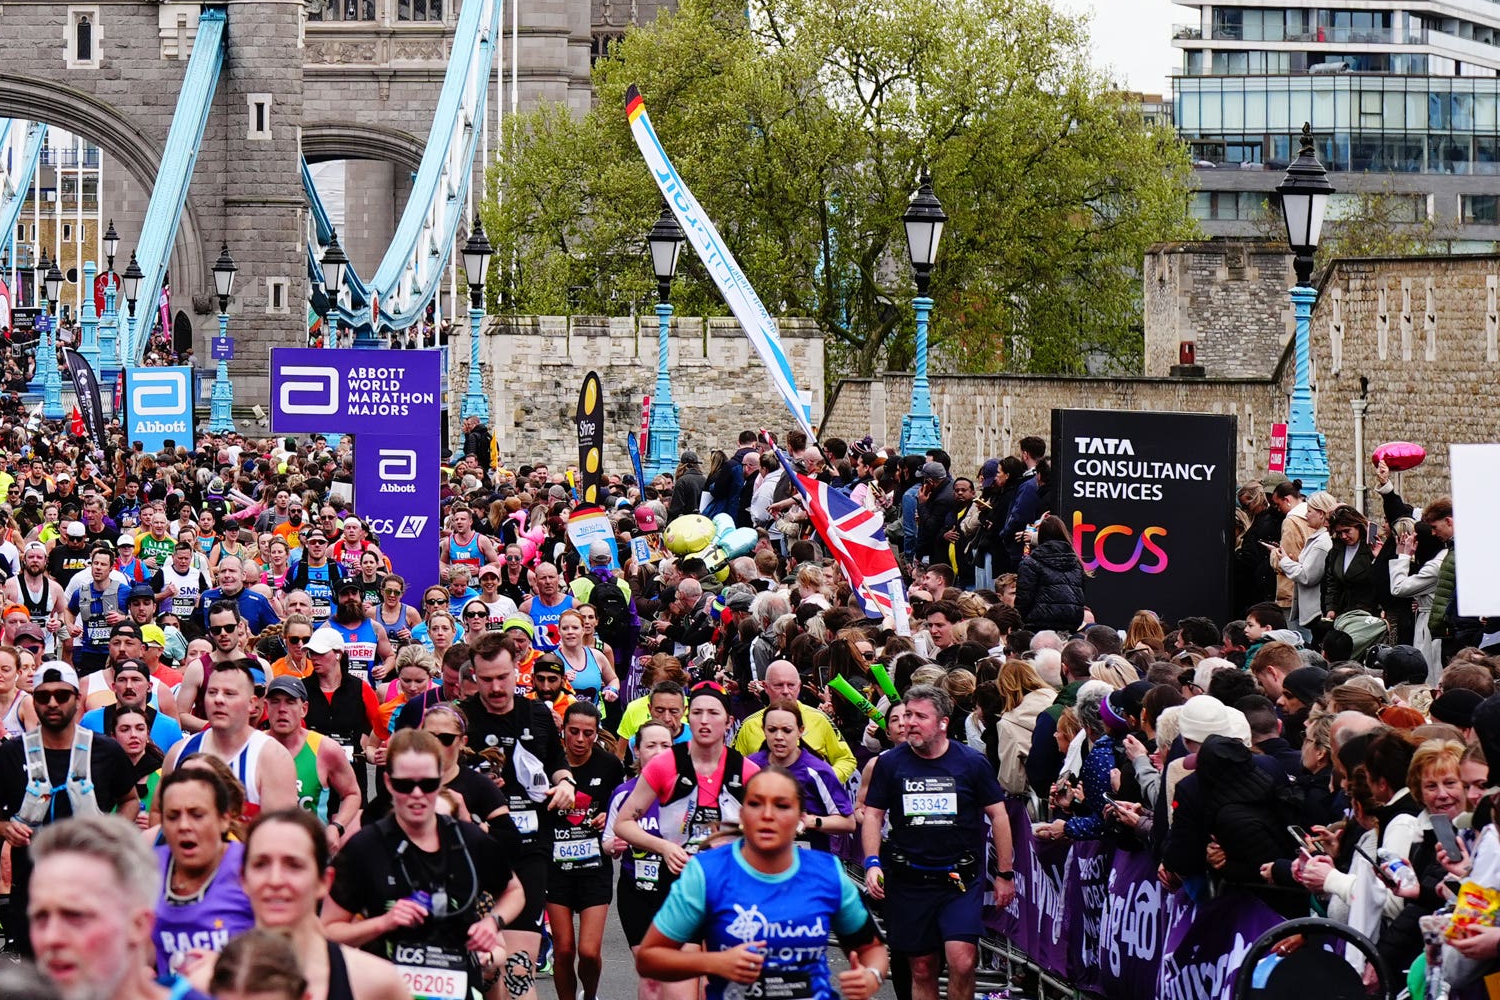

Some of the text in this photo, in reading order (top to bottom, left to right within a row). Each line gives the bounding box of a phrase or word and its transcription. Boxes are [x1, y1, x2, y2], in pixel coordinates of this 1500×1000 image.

[347, 367, 405, 380] ABBOTT
[347, 379, 400, 392] WORLD
[347, 392, 434, 404] MARATHON
[347, 404, 409, 416] MAJORS
[134, 420, 187, 433] Abbott
[579, 420, 596, 438] Shine
[1074, 436, 1135, 456] TATA
[1073, 459, 1216, 481] CONSULTANCY
[379, 483, 416, 493] Abbott
[1073, 480, 1163, 501] SERVICES
[365, 515, 394, 534] tcs
[1072, 510, 1169, 574] tcs
[344, 648, 374, 658] RIDERS
[905, 779, 925, 791] tcs
[912, 797, 949, 811] 53342
[554, 828, 570, 840] tcs
[559, 842, 592, 858] 64287
[764, 916, 827, 938] mind
[395, 944, 425, 965] tcs
[403, 973, 455, 995] 26205
